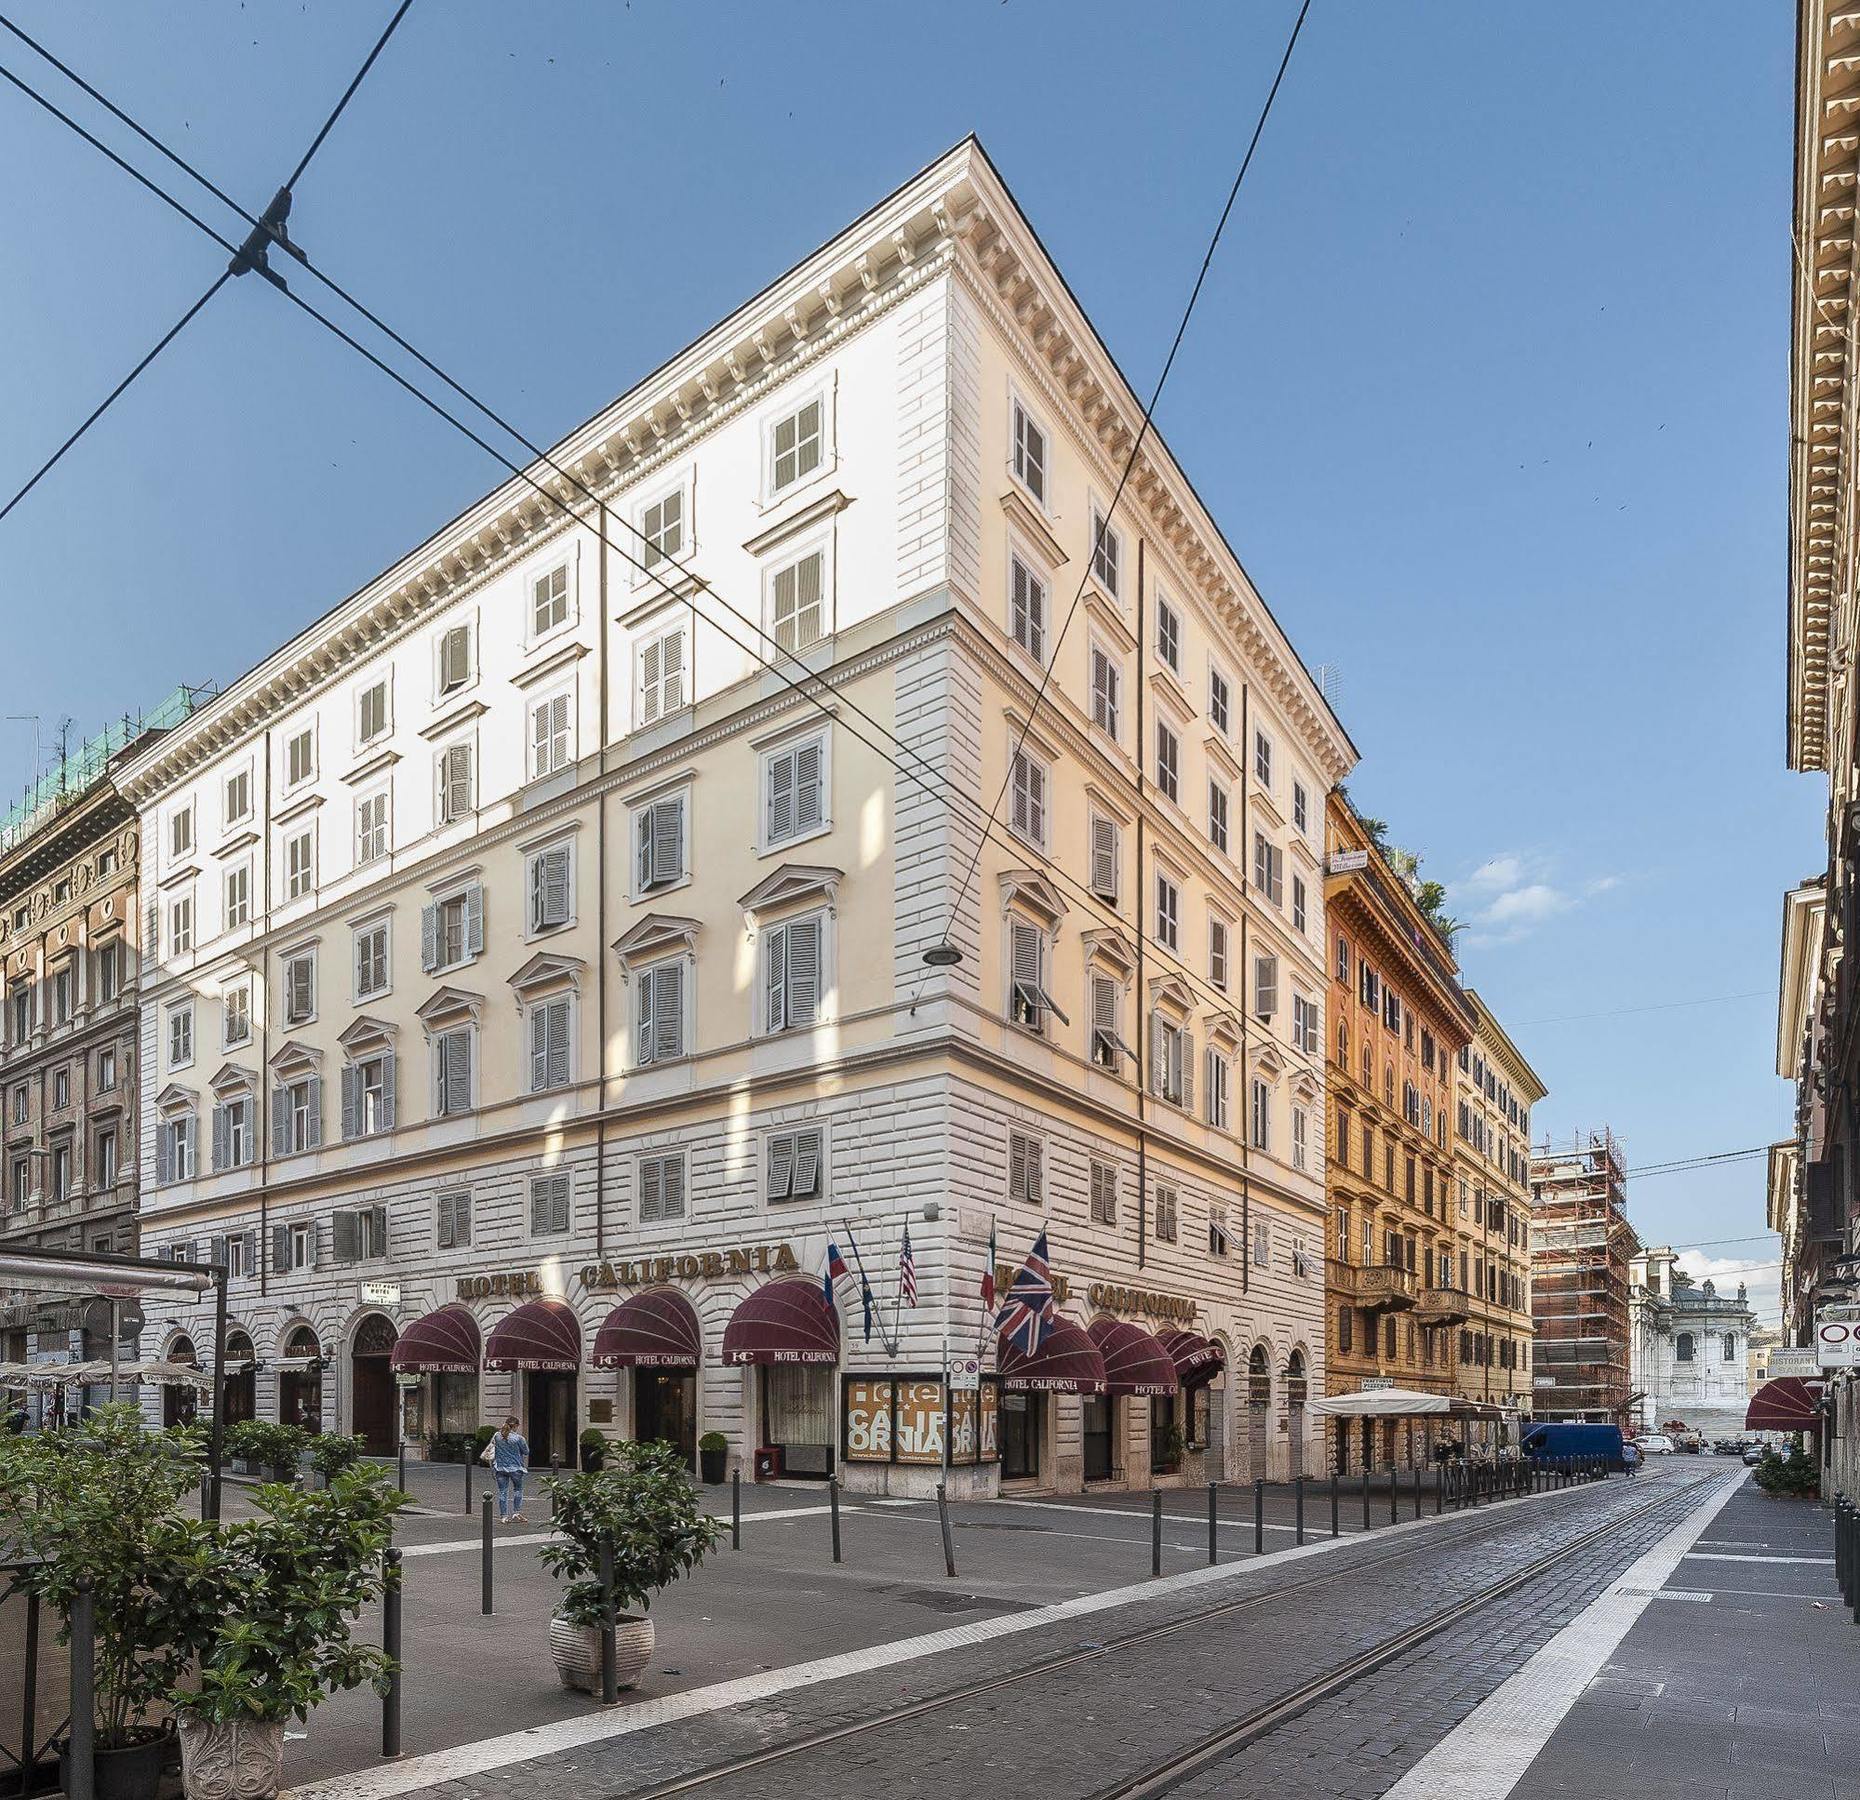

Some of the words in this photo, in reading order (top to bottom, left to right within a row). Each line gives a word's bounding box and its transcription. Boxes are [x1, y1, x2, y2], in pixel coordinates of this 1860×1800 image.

[580, 1243, 800, 1288] CALIFORNIA
[456, 1270, 544, 1299] HOTEL
[1088, 1283, 1198, 1319] CALIFORNIA
[635, 1355, 659, 1365] HOTEL
[661, 1356, 696, 1365] CALIFORNIA
[774, 1351, 800, 1361] HOTEL
[802, 1352, 836, 1362] CALIFORNIA
[1770, 1357, 1816, 1366] RISTORANT
[419, 1363, 441, 1372] HOTEL
[517, 1360, 540, 1369] HOTEL
[542, 1361, 576, 1370] CALIFORNIA
[1004, 1379, 1029, 1389] HOTEL
[1031, 1379, 1078, 1390] CALIFORNIA
[1135, 1384, 1167, 1395] HOTEL
